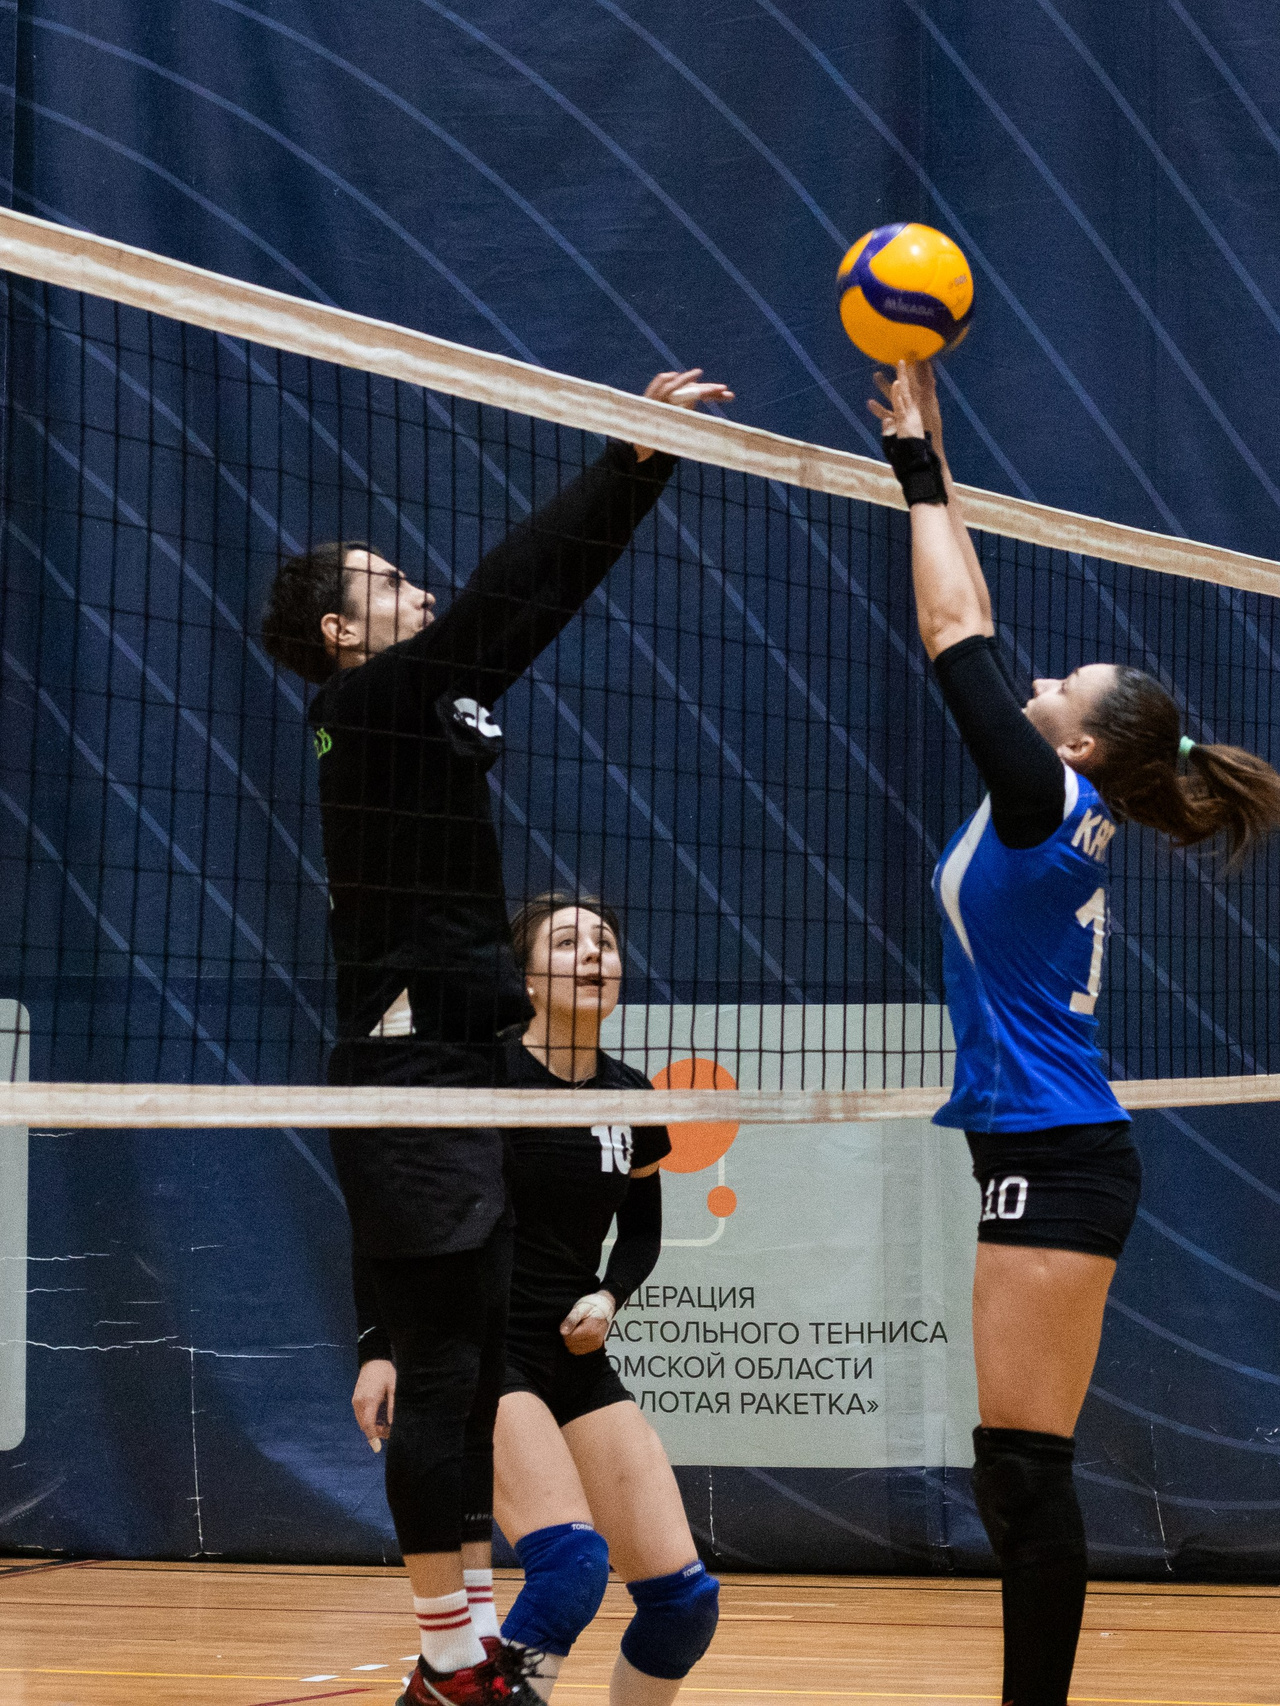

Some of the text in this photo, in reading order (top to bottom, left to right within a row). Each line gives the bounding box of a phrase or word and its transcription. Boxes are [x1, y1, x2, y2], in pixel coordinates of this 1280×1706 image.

[591, 1126, 633, 1175] 10
[982, 1175, 1028, 1220] 10
[605, 1320, 948, 1344] АСТОЛЬНОГО ТЕННИСА
[735, 1356, 872, 1380] ОБЛАСТИ
[628, 1390, 879, 1415] ЛОТАЯ РАКЕТКА»
